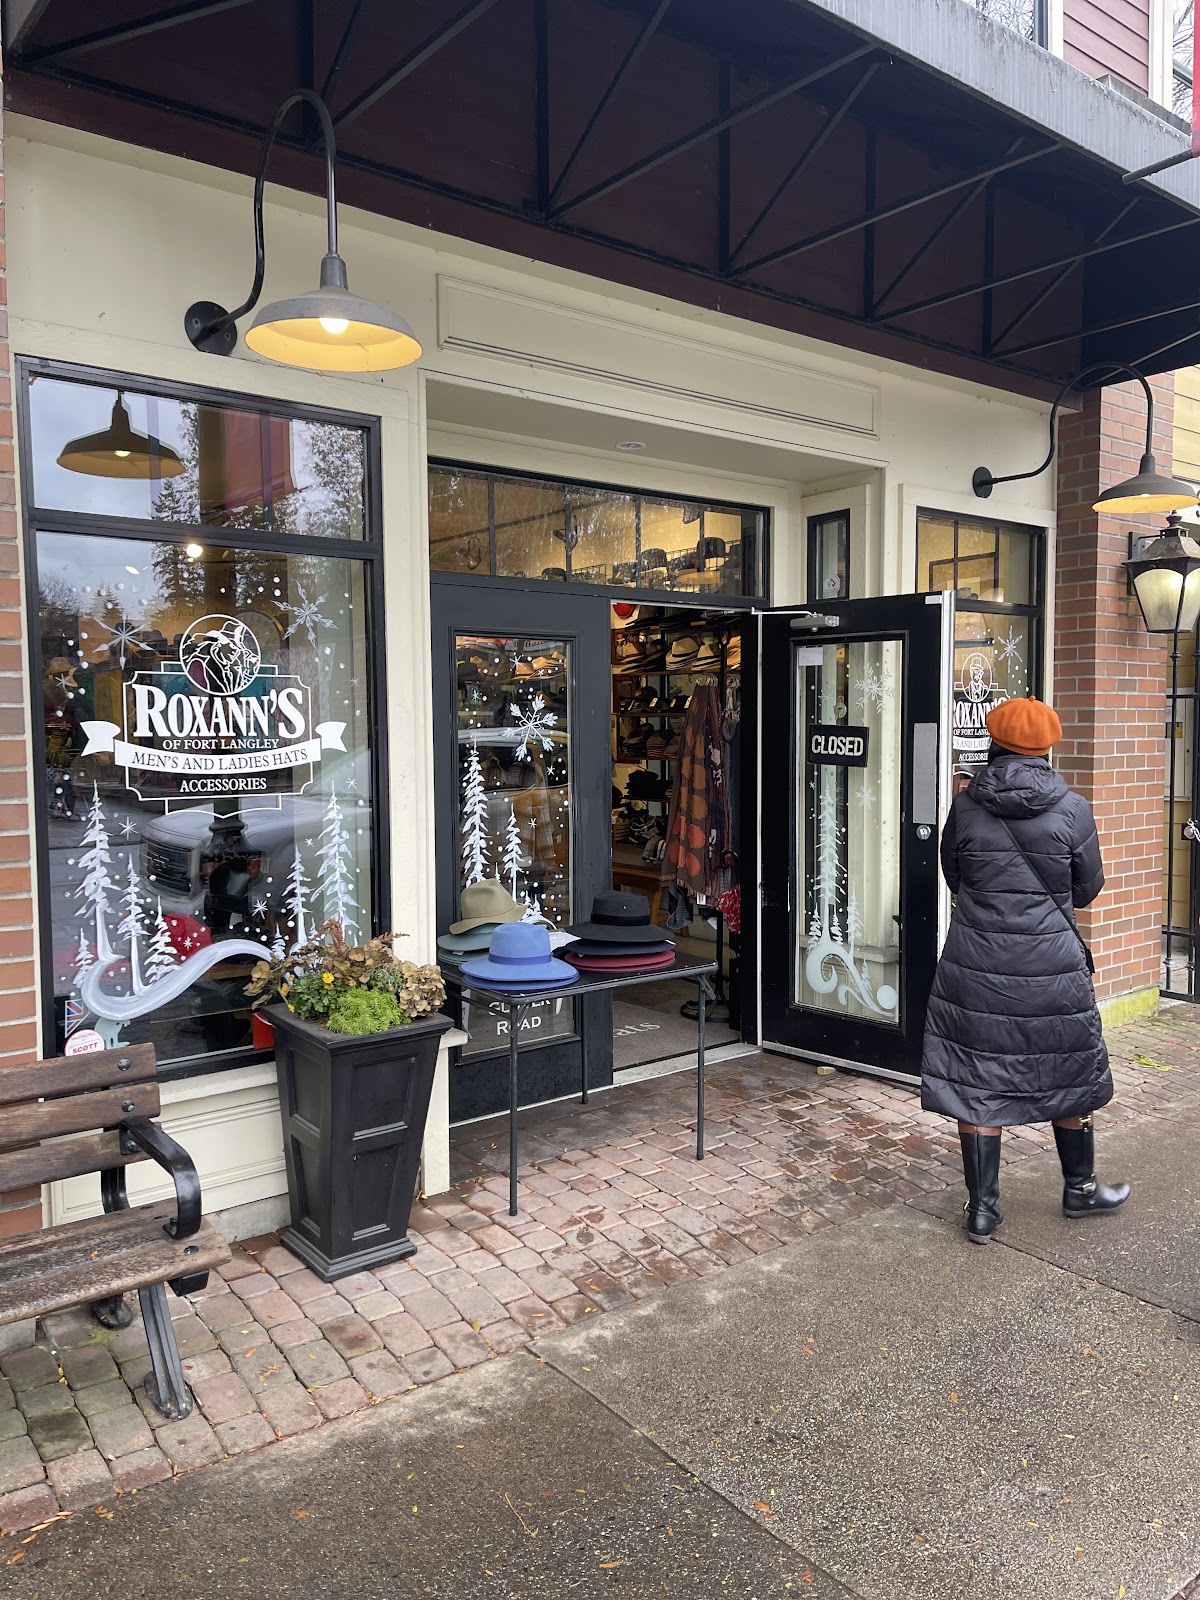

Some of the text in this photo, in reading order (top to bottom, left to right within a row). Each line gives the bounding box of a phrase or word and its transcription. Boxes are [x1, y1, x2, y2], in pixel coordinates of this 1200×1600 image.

[132, 684, 306, 738] ROXANN'S
[953, 728, 961, 736] OF
[961, 728, 974, 736] FORT
[163, 738, 280, 750] OF FORT LANGLEY
[811, 735, 864, 756] CLOSED
[960, 739, 973, 748] AND
[132, 748, 309, 771] MEN'S AND LADIES HATS
[959, 752, 989, 761] ACCESSORIE
[180, 777, 267, 793] ACCESSORIES
[496, 1016, 542, 1036] RAD
[613, 1022, 661, 1038] ats
[72, 1042, 98, 1054] SCOTT
